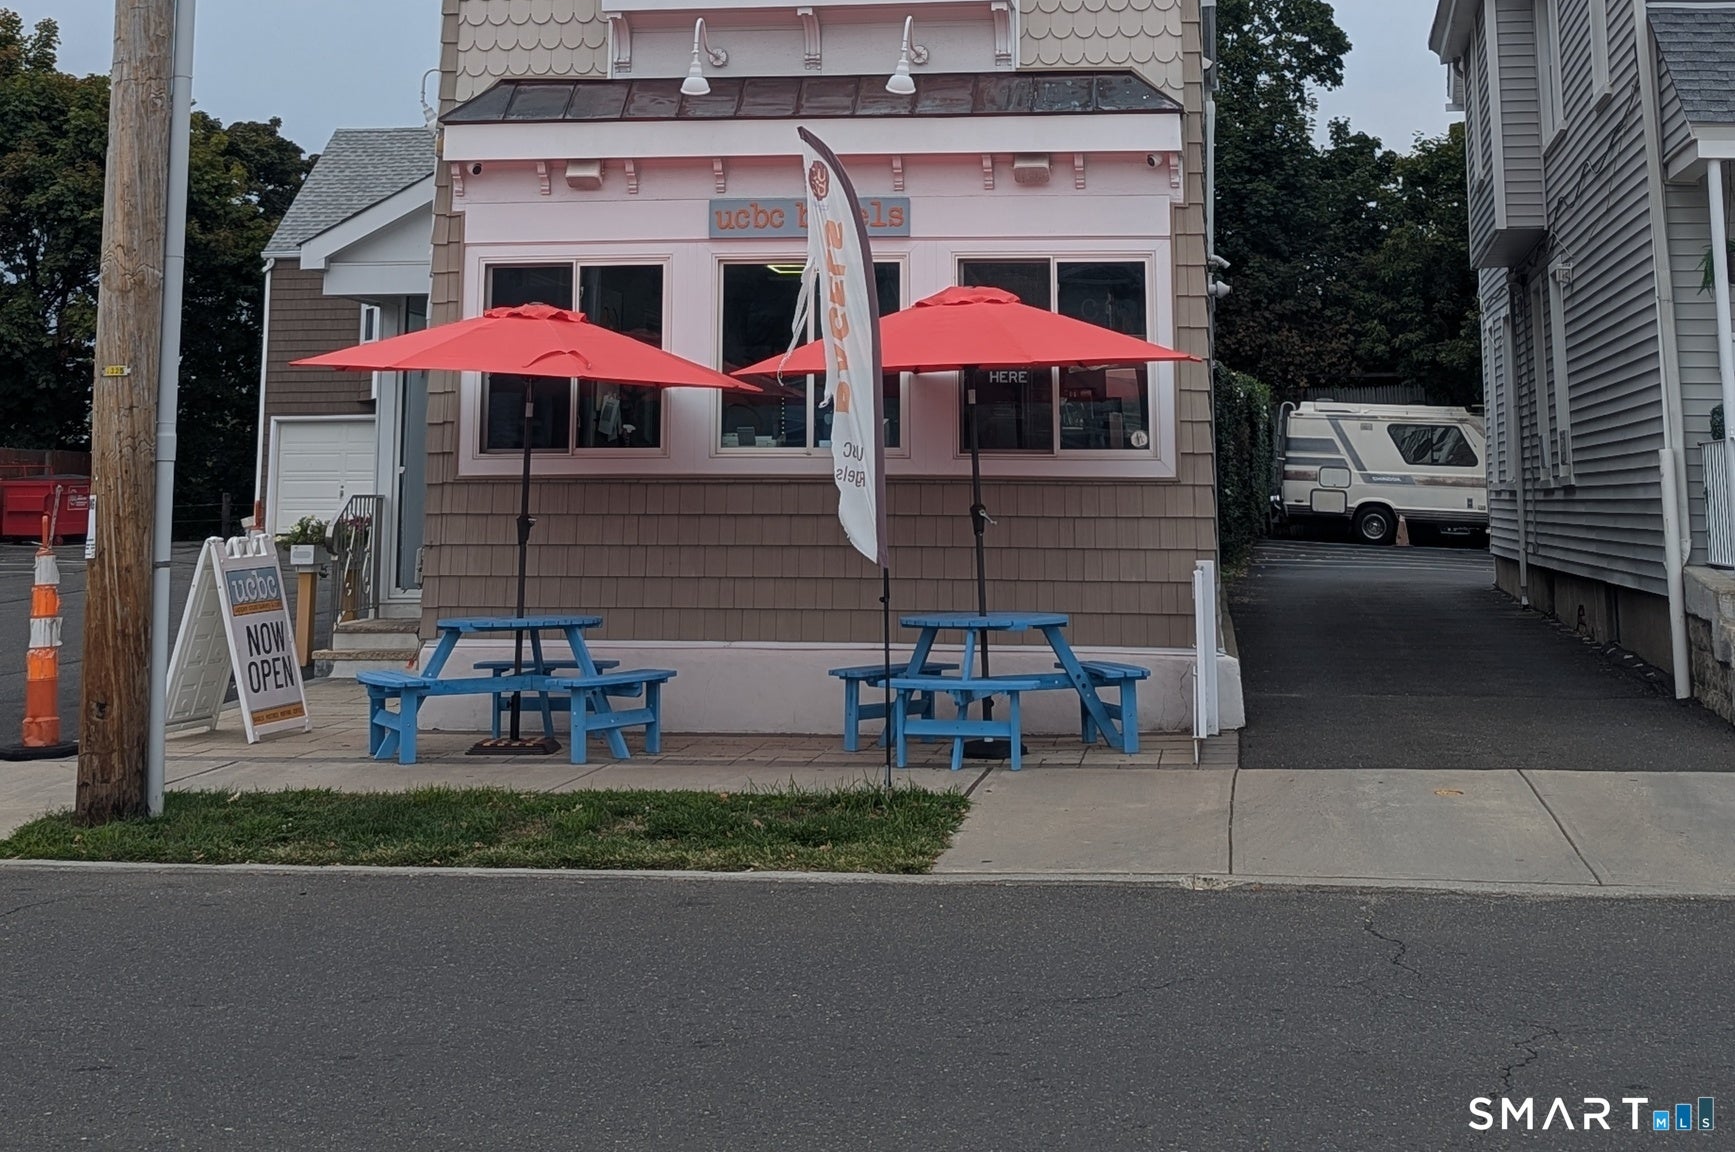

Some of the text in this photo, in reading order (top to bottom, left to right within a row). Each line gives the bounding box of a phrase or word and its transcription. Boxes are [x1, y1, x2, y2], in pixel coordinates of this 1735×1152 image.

[715, 201, 905, 230] ucbc bels
[989, 371, 1028, 384] HERE
[231, 570, 278, 603] ucbc
[246, 621, 285, 657] NOW
[247, 655, 295, 694] OPEN
